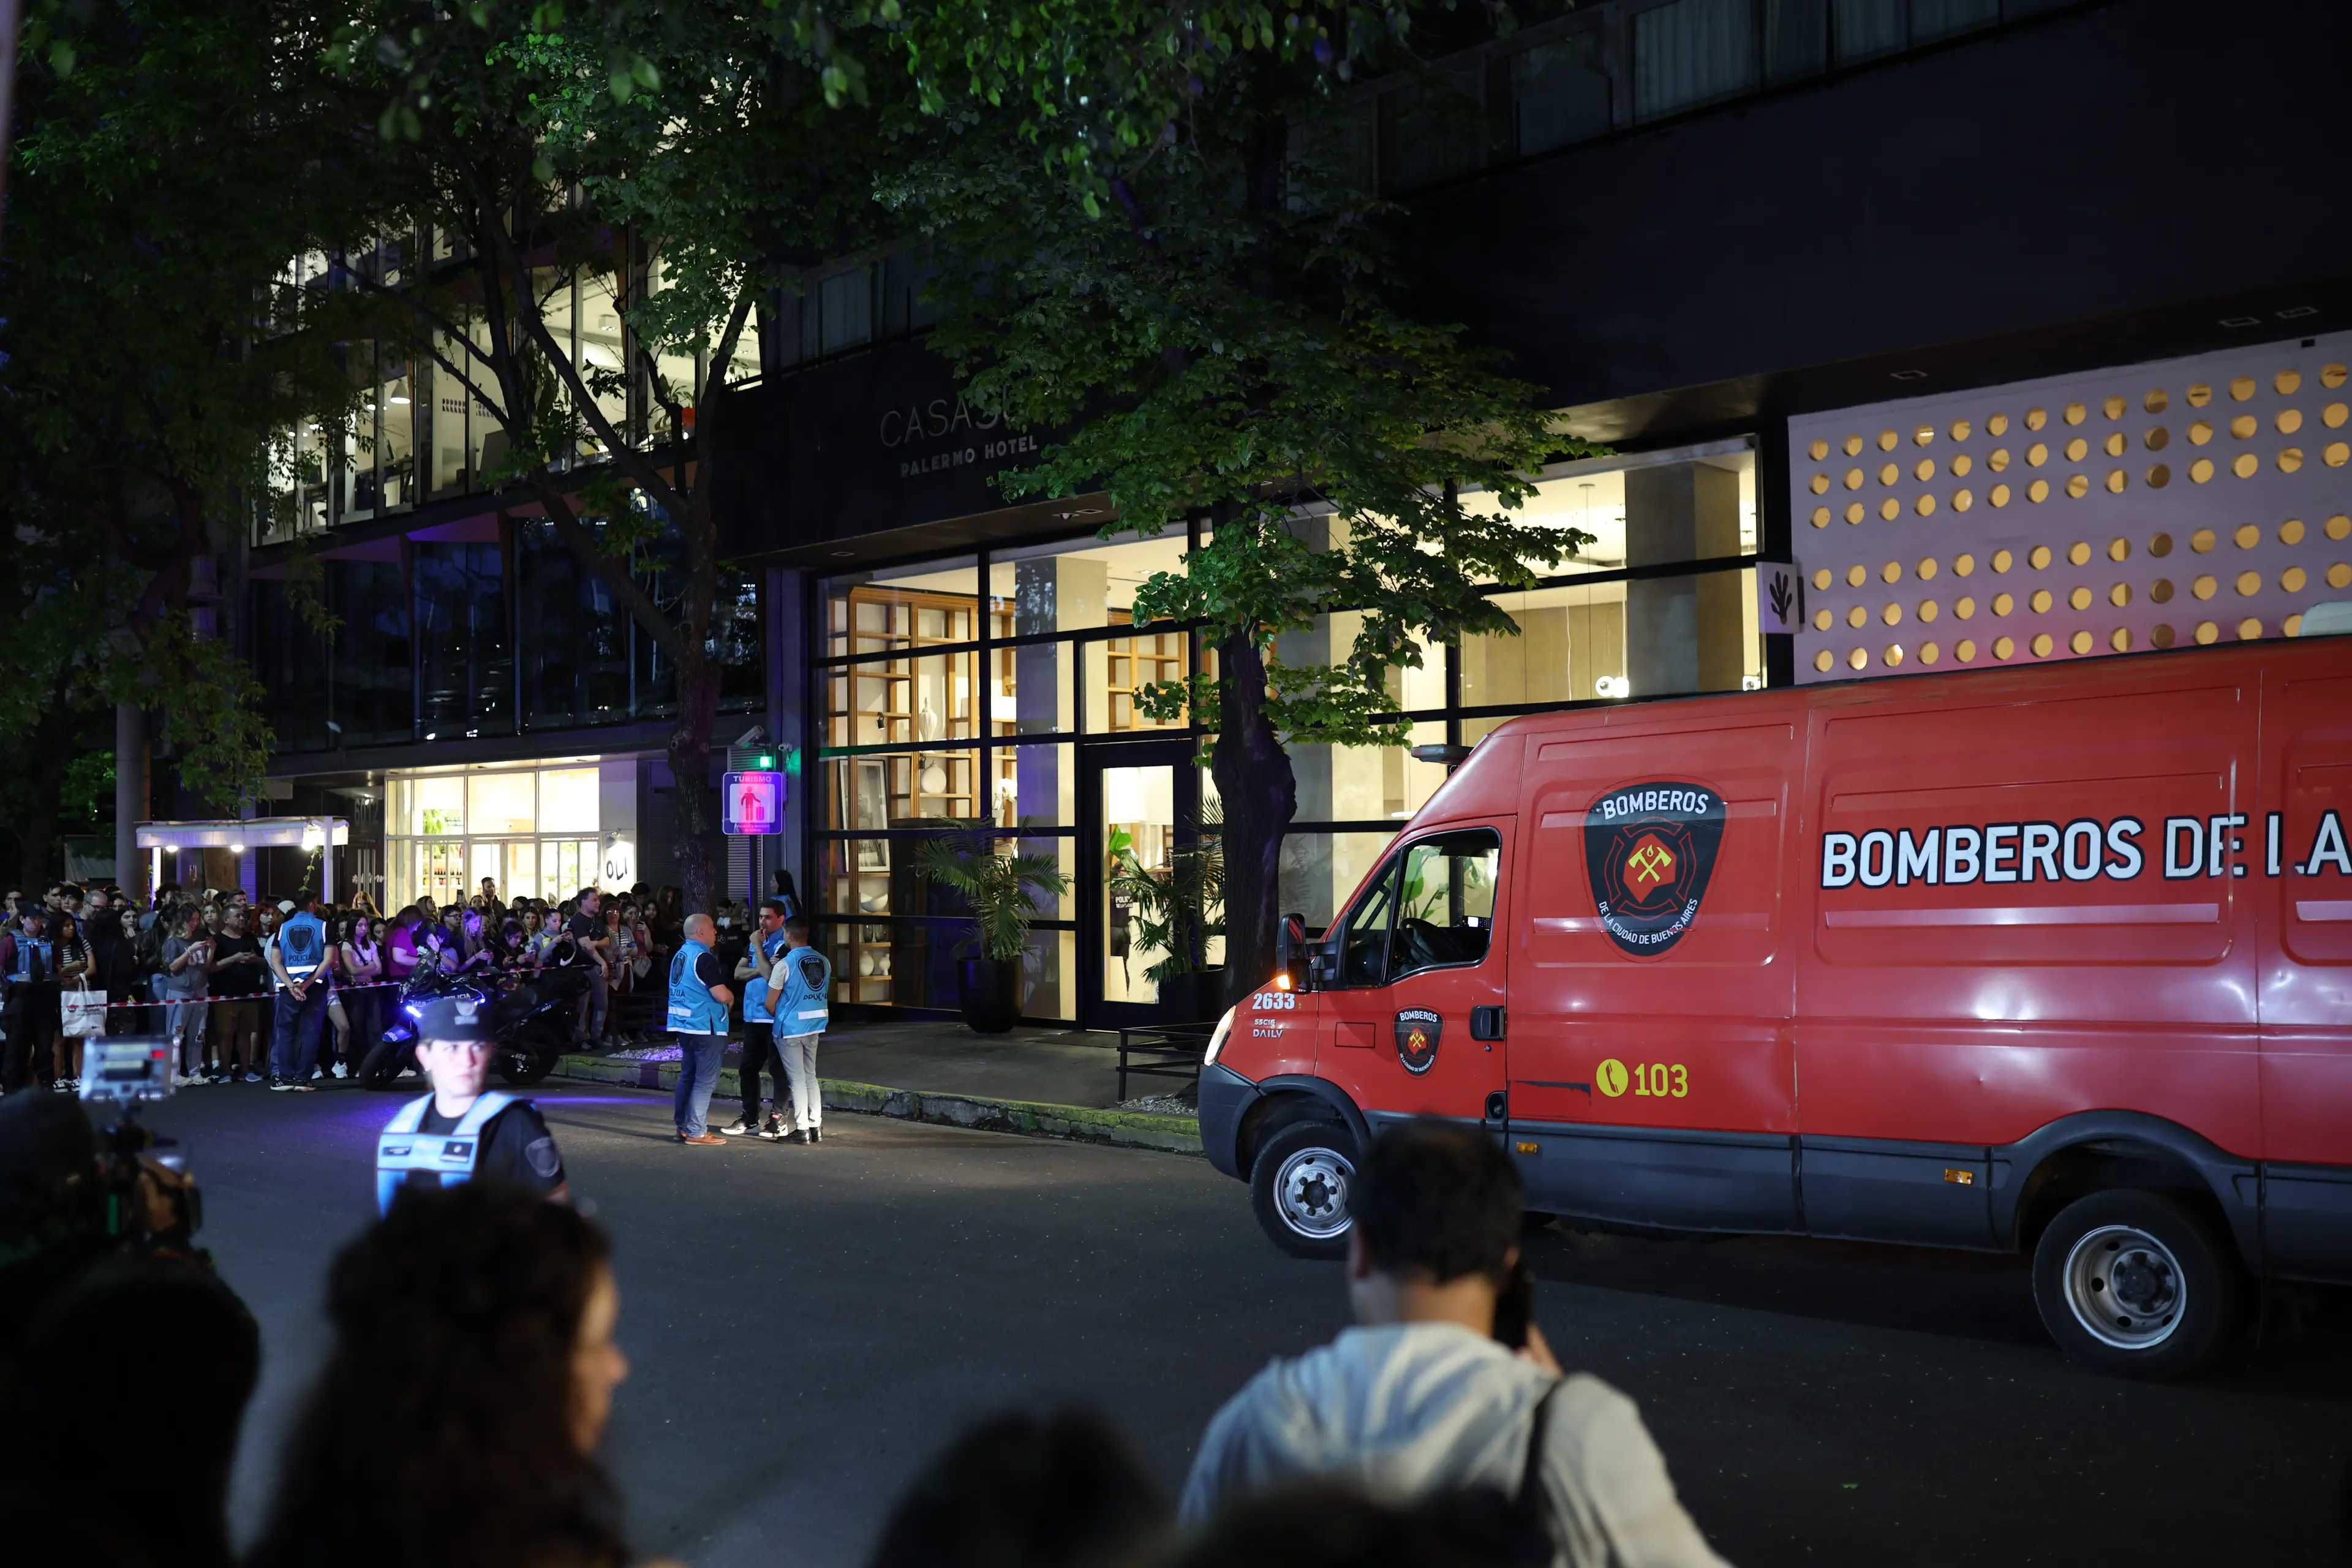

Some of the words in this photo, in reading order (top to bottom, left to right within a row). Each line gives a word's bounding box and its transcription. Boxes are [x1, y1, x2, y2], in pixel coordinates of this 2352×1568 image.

[900, 448, 976, 478] PALERMO
[984, 435, 1038, 459] HOTEL
[1602, 790, 1709, 820] BOMBEROS
[1822, 818, 2143, 888] BOMBEROS
[2165, 814, 2247, 878] DE
[606, 856, 628, 881] OLI
[1599, 901, 1609, 914] DE
[1604, 914, 1614, 927] LA
[1612, 923, 1638, 944] CIUDAD
[1639, 934, 1650, 944] DE
[1651, 920, 1683, 943] BUENOS
[1681, 898, 1698, 924] AIRES
[1252, 992, 1295, 1010] 2633
[1400, 1011, 1438, 1023] BOMBEROS
[1253, 1028, 1284, 1038] DAILY
[1404, 1062, 1414, 1071] CIUDAD
[1419, 1063, 1430, 1072] BUENOS
[1634, 1063, 1688, 1098] 103
